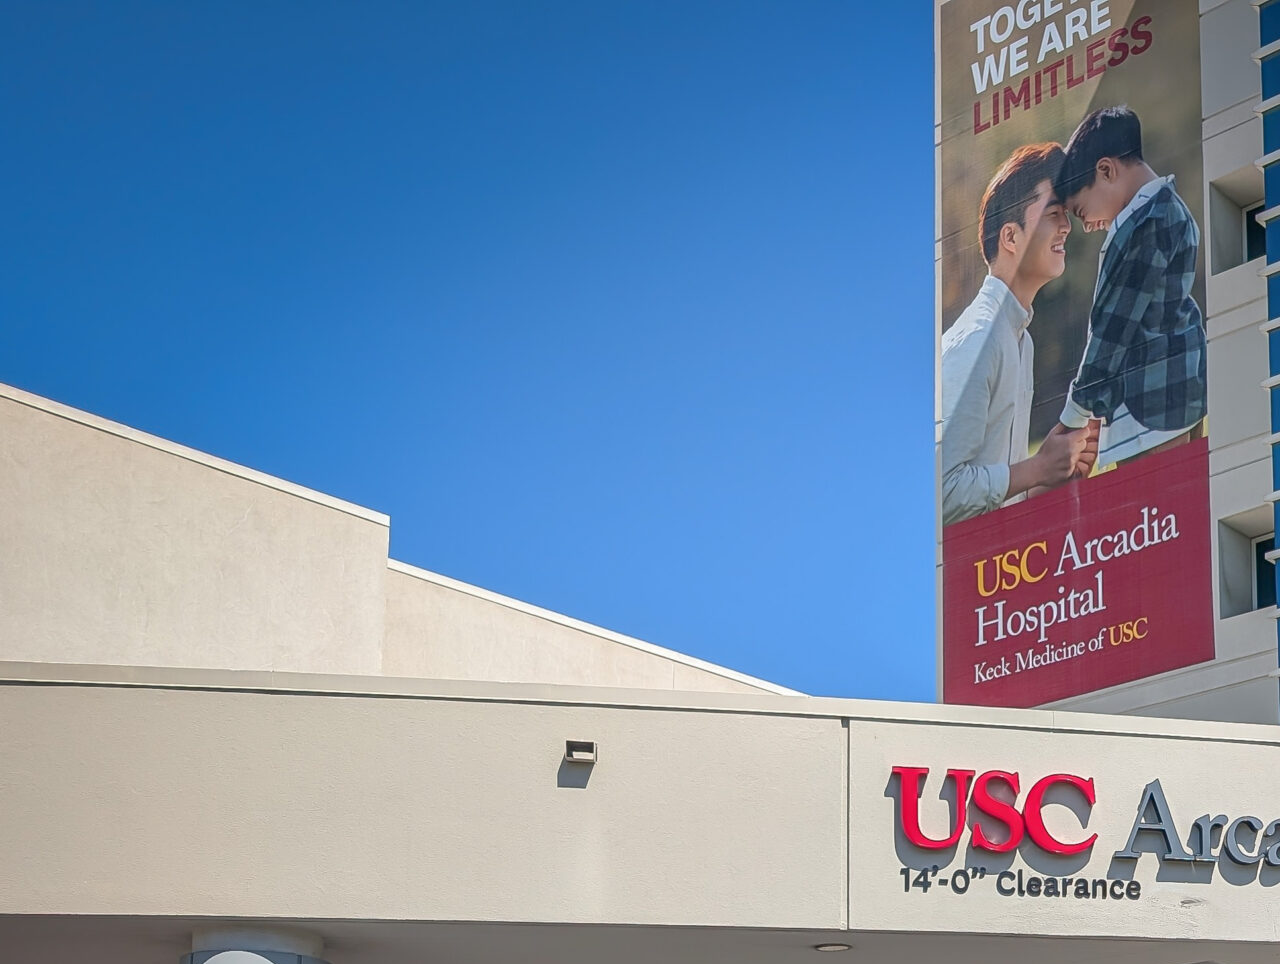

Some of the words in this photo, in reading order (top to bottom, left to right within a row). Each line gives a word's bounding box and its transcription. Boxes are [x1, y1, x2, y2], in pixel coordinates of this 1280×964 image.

[970, 0, 1078, 54] TOGE
[971, 36, 1029, 95] WE
[1037, 0, 1112, 64] ARE
[973, 15, 1153, 136] LIMITLESS
[974, 541, 1049, 598] USC
[1053, 506, 1180, 577] Arcadia
[974, 570, 1107, 647] Hospital
[974, 657, 1012, 685] Keck
[1014, 641, 1086, 674] Medicine
[1088, 628, 1107, 651] of
[1108, 617, 1149, 647] USC
[891, 766, 1099, 856] USC
[996, 869, 1142, 901] Clearance
